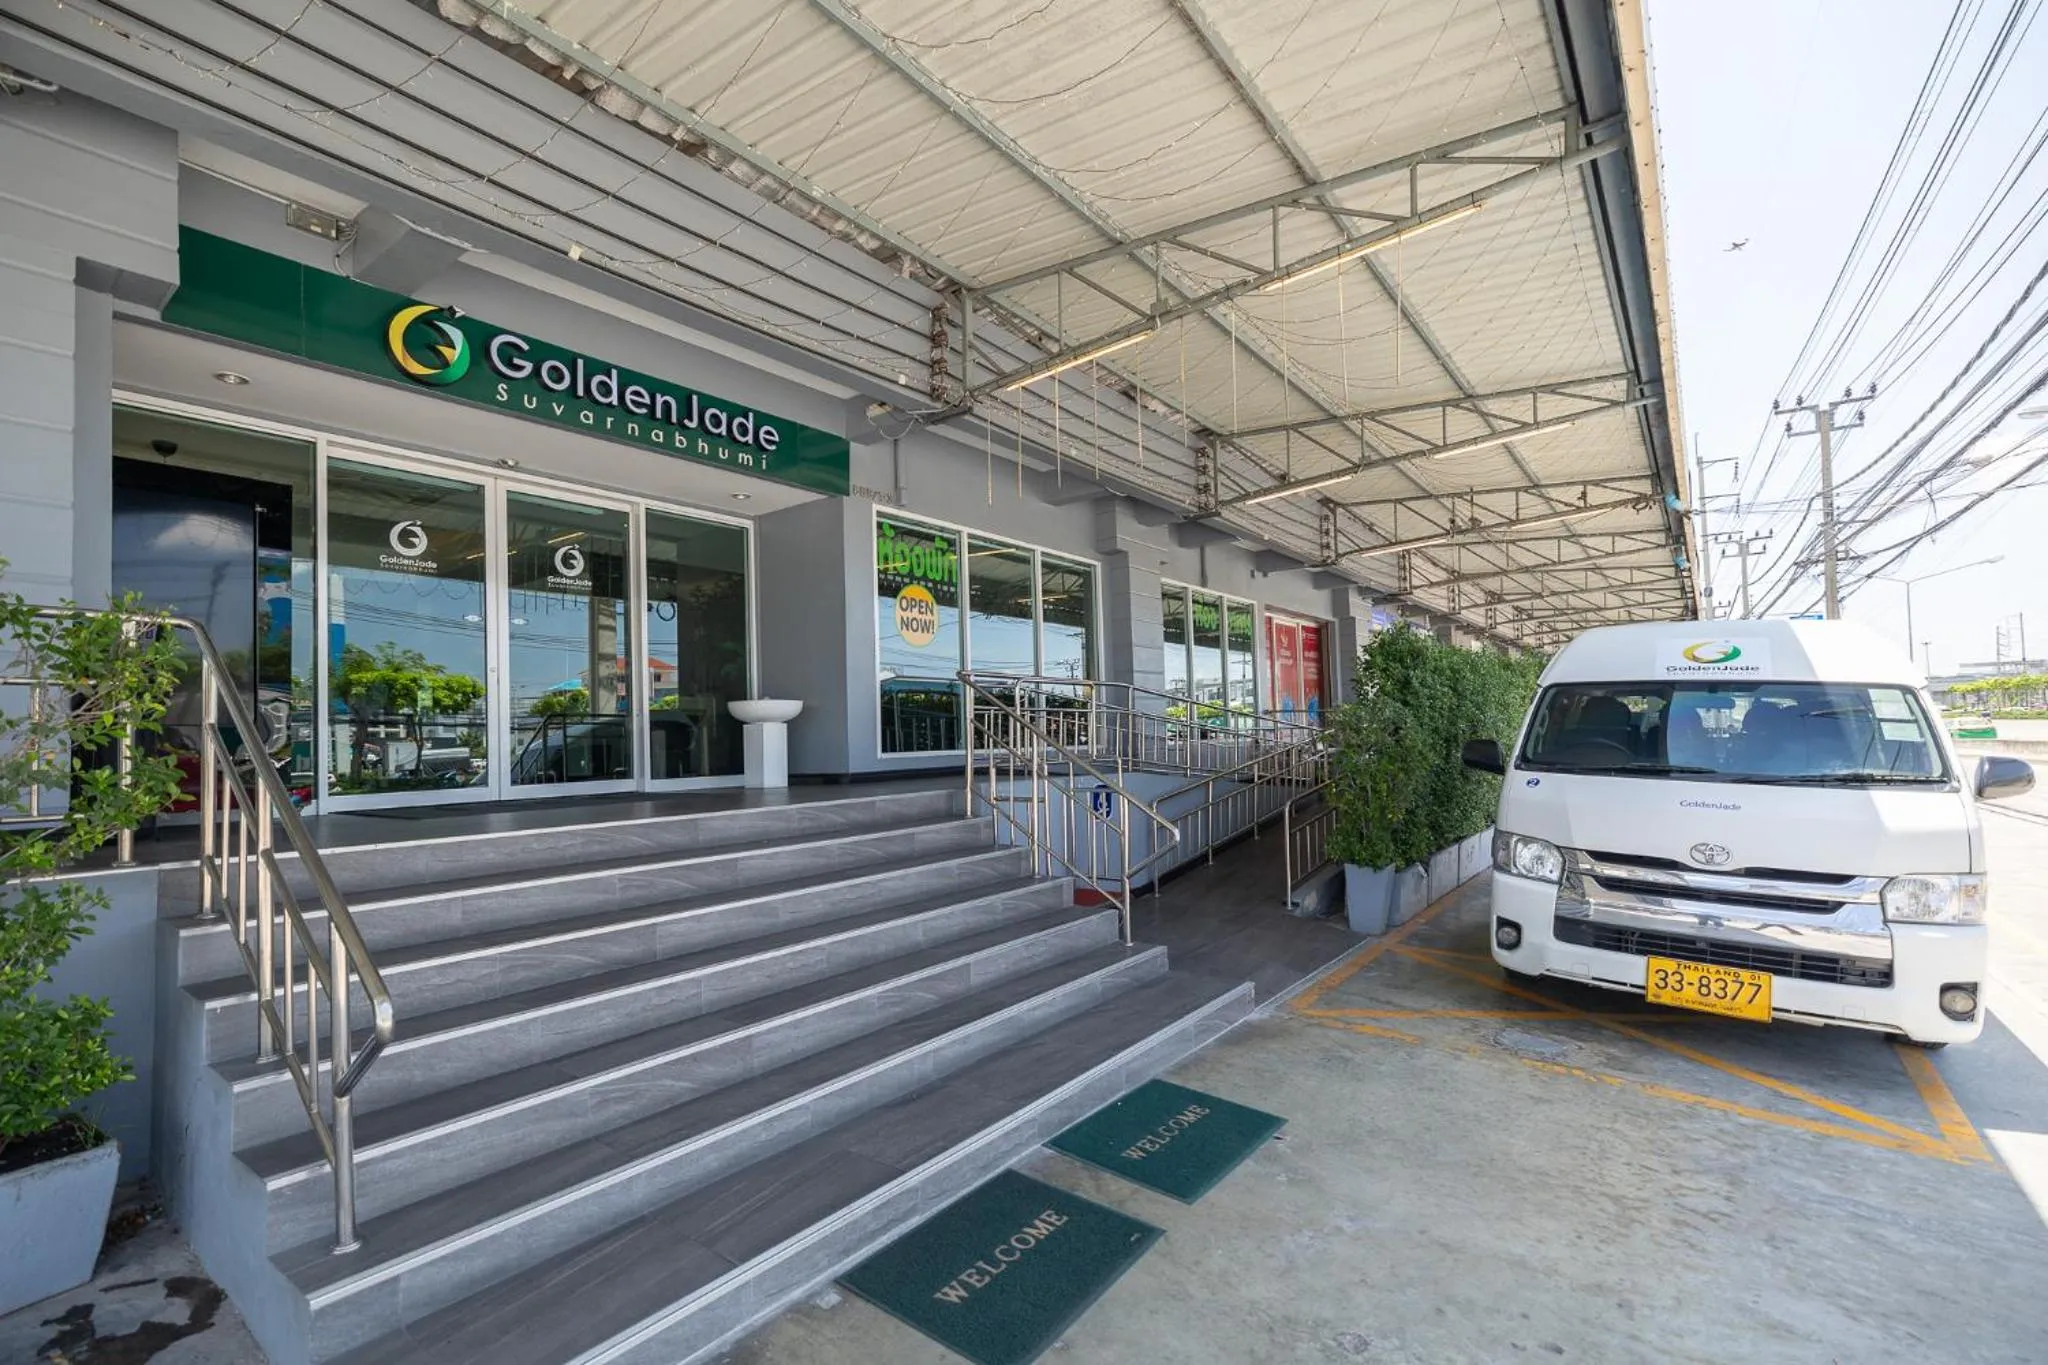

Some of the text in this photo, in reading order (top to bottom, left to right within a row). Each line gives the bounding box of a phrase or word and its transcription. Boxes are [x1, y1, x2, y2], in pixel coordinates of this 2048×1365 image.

[488, 333, 780, 450] GoldenJade
[496, 383, 767, 471] Suvarnabhumi
[899, 596, 934, 617] OPEN
[900, 615, 935, 635] NOW!
[1654, 968, 1762, 1005] 33-8377
[1676, 963, 1741, 979] THAILAND
[1121, 1104, 1211, 1161] WELCOME
[932, 1209, 1069, 1306] WELCOME
